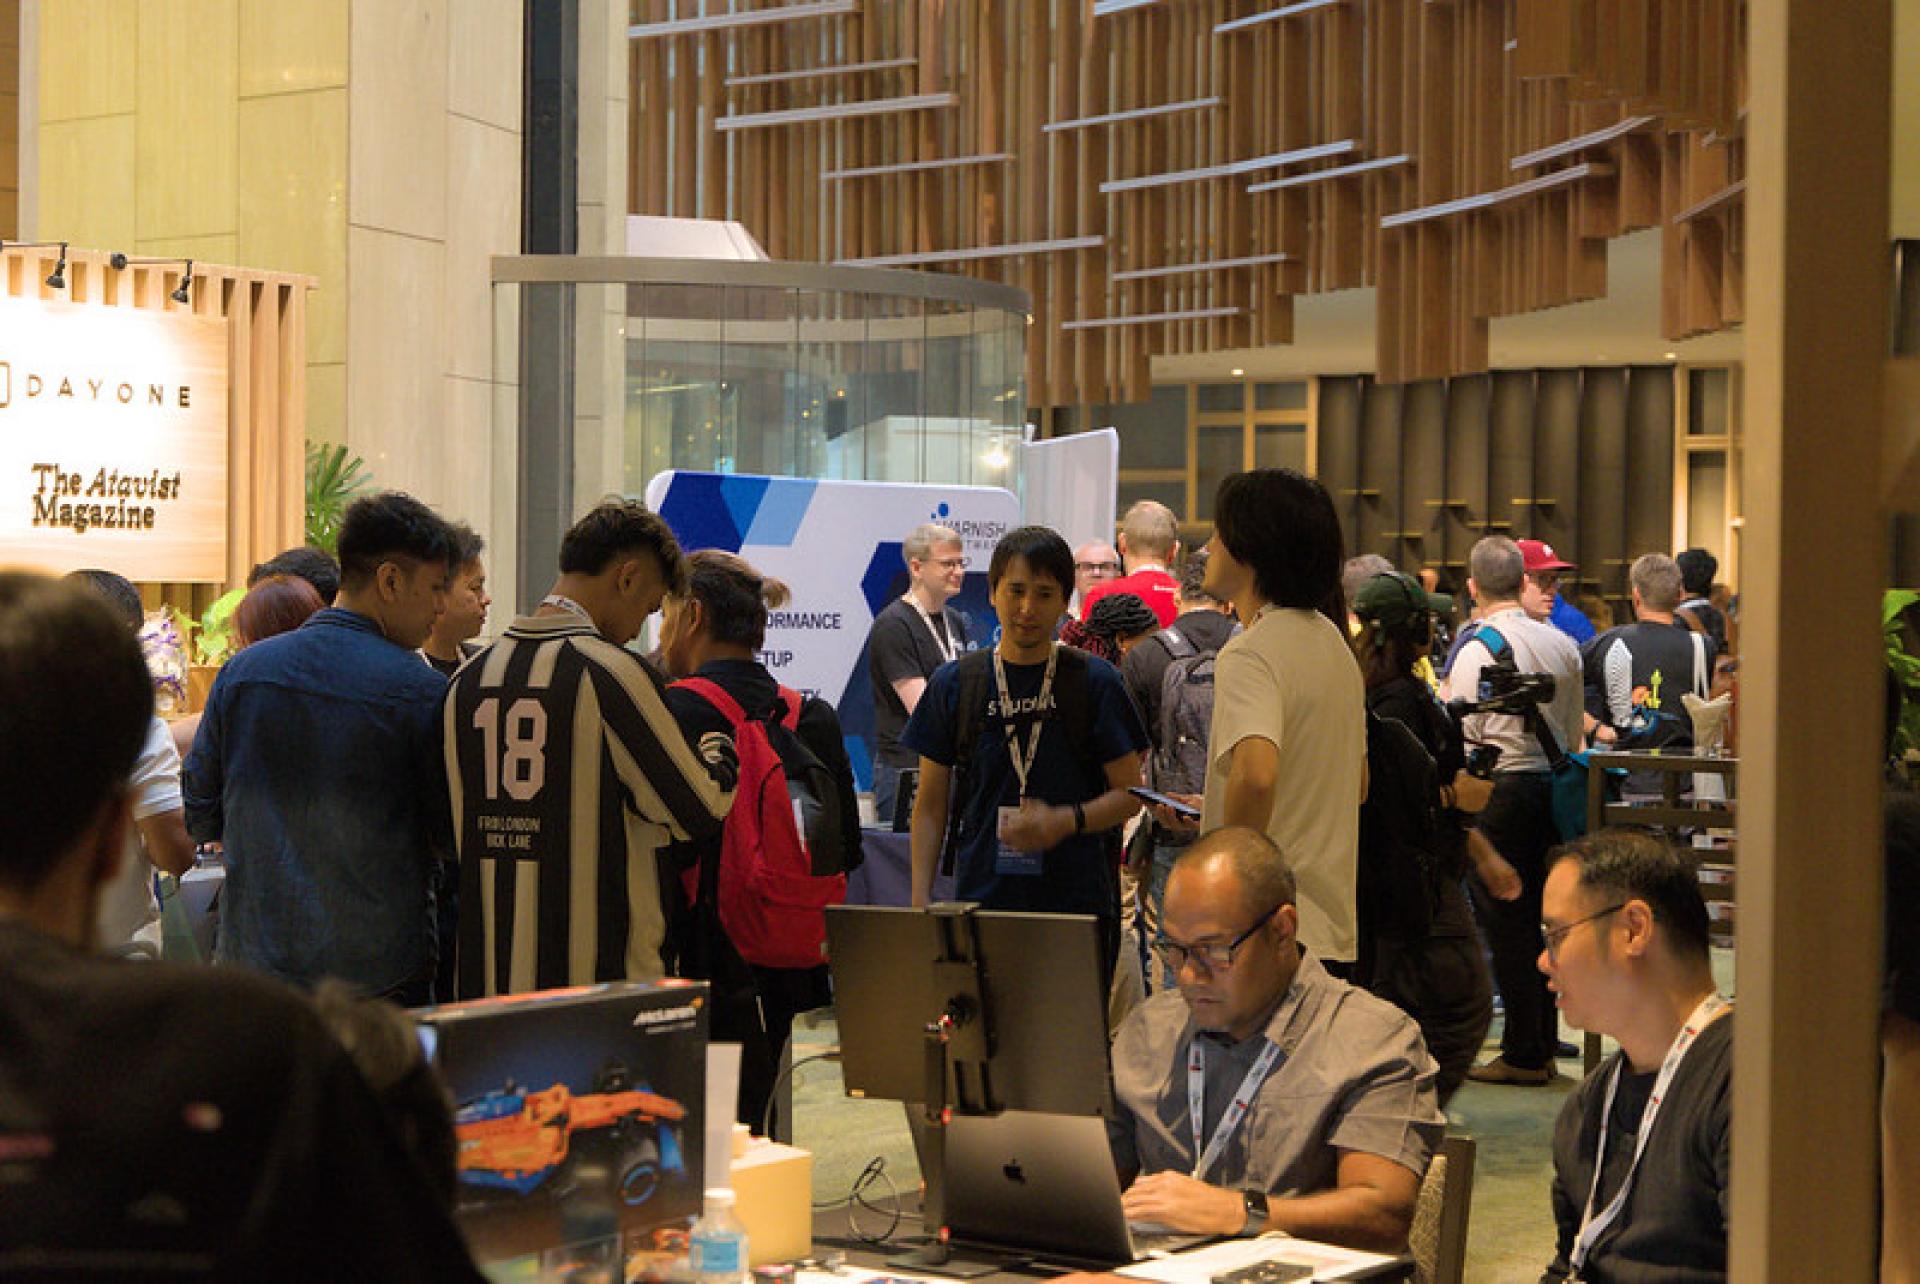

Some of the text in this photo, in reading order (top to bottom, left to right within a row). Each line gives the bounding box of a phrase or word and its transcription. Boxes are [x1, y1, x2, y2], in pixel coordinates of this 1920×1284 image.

[27, 373, 191, 408] DAYONE
[31, 462, 181, 500] The Atavist
[31, 494, 156, 533] Magazine
[767, 611, 841, 630] ORMANCE
[754, 649, 793, 668] ETUP
[473, 697, 548, 801] 18
